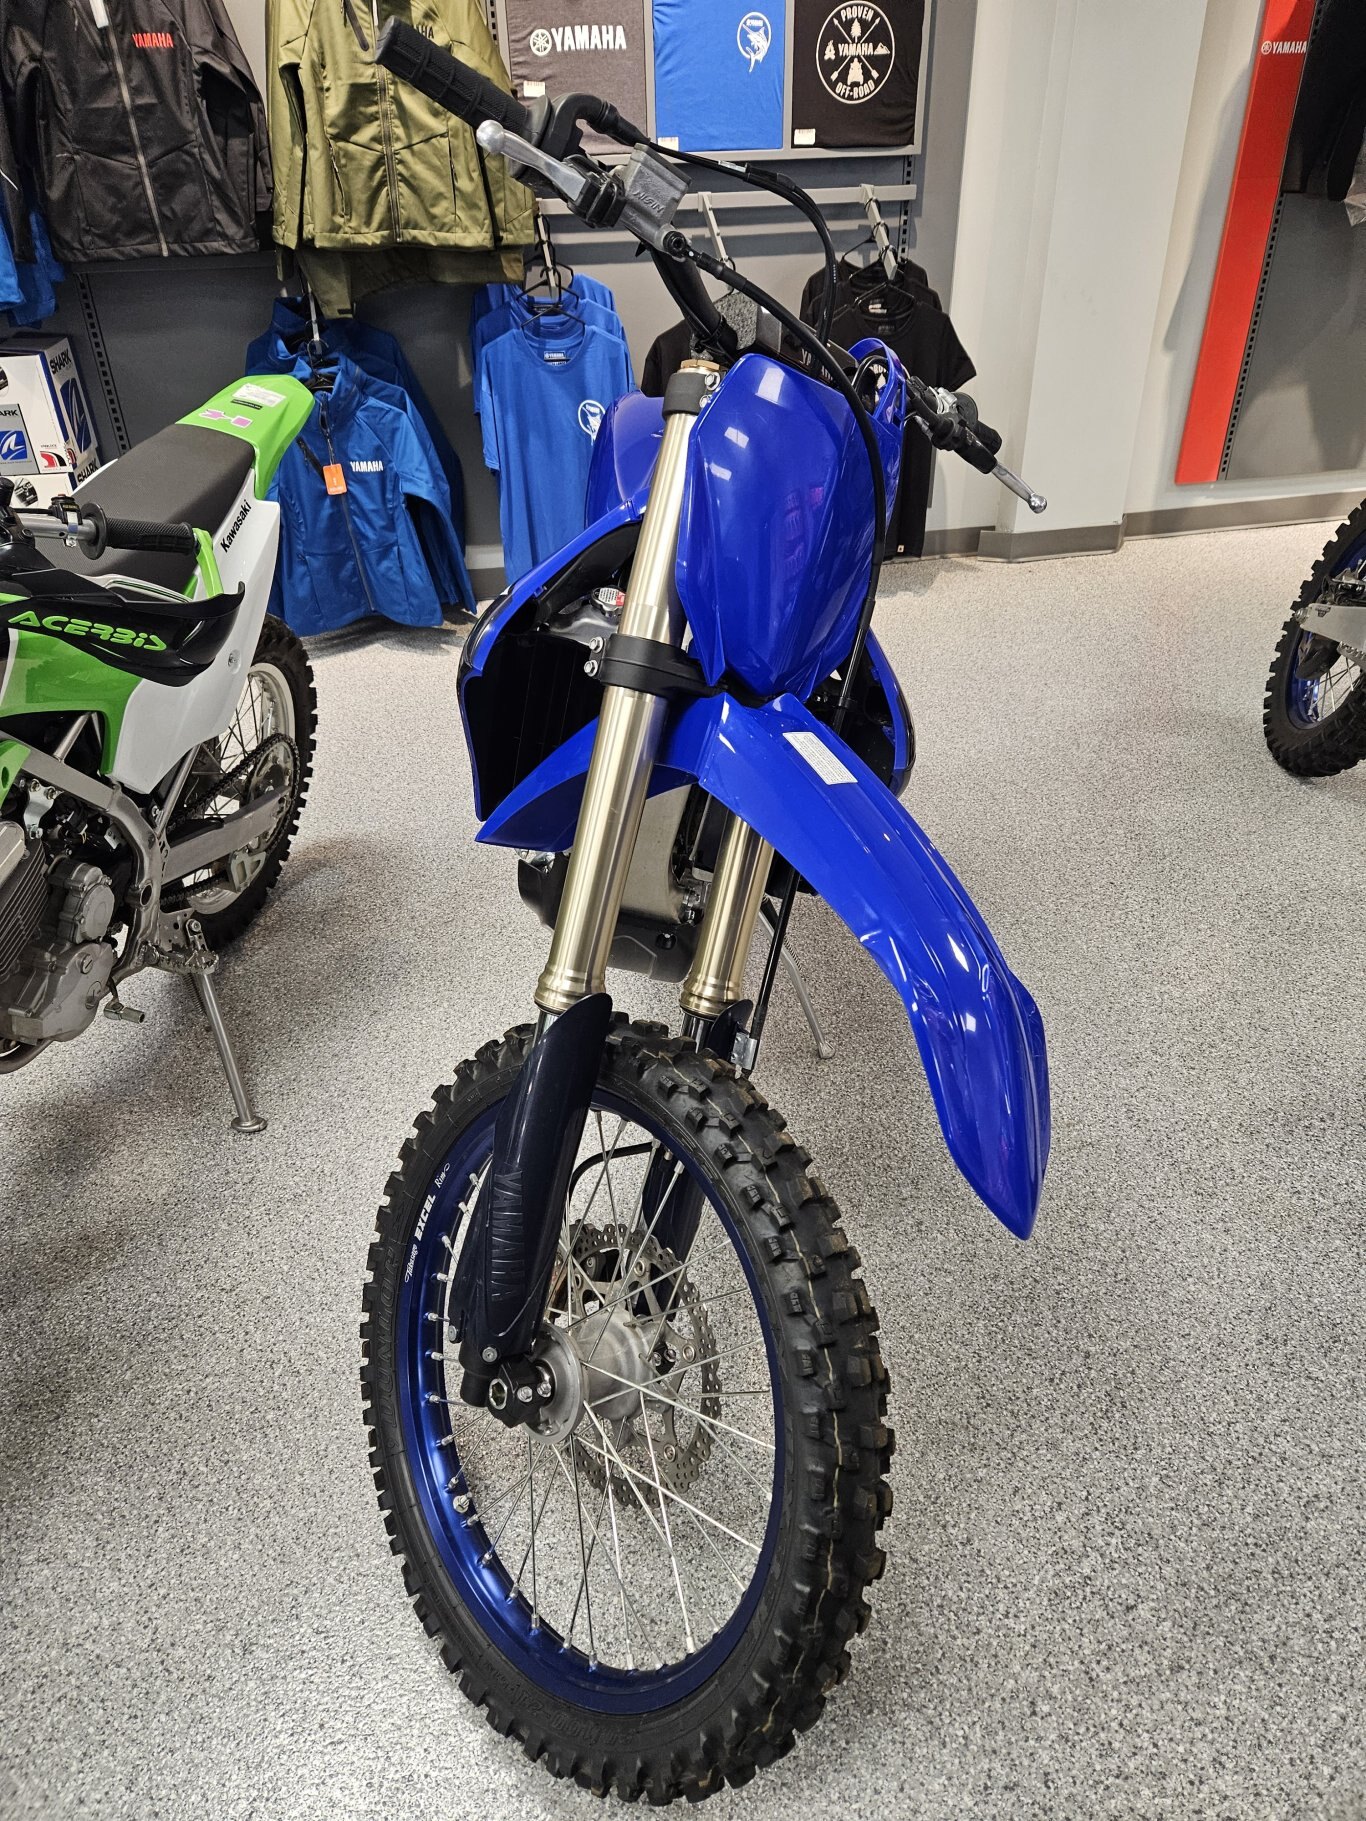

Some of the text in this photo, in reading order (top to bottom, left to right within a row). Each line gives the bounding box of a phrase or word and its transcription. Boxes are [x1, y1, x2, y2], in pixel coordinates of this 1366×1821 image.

[840, 5, 874, 22] PROVEN
[131, 32, 174, 48] YAMAHA
[550, 24, 627, 52] YAMAHA
[838, 42, 874, 57] YAMAHA
[1272, 40, 1308, 55] YAMAHA
[49, 348, 72, 375] SHARK
[350, 460, 384, 473] YAMAHA
[220, 498, 252, 553] Kawasaki
[8, 610, 167, 651] ACERBIS
[414, 1194, 436, 1241] EXCEL
[434, 1162, 451, 1189] Rim
[491, 1170, 523, 1302] YAMAHA
[377, 1246, 398, 1428] DUNLOP
